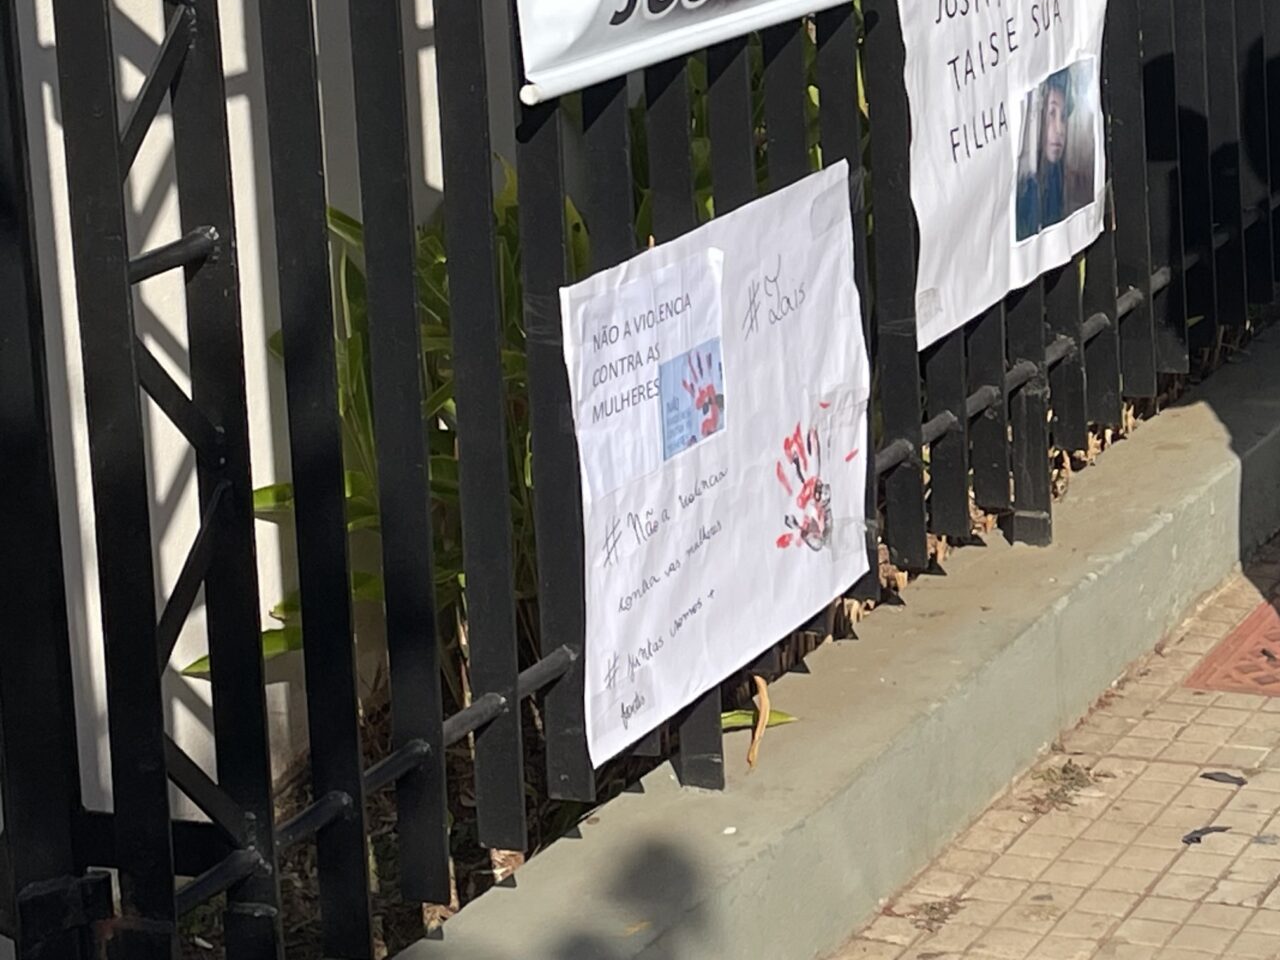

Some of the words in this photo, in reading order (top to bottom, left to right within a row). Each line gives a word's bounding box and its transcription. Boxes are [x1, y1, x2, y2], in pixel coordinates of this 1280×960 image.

[949, 101, 1008, 164] FILHA
[593, 324, 619, 353] NÃO
[623, 319, 632, 340] A
[592, 350, 643, 388] CONTRA
[646, 342, 660, 364] AS
[592, 377, 660, 424] MULHERES
